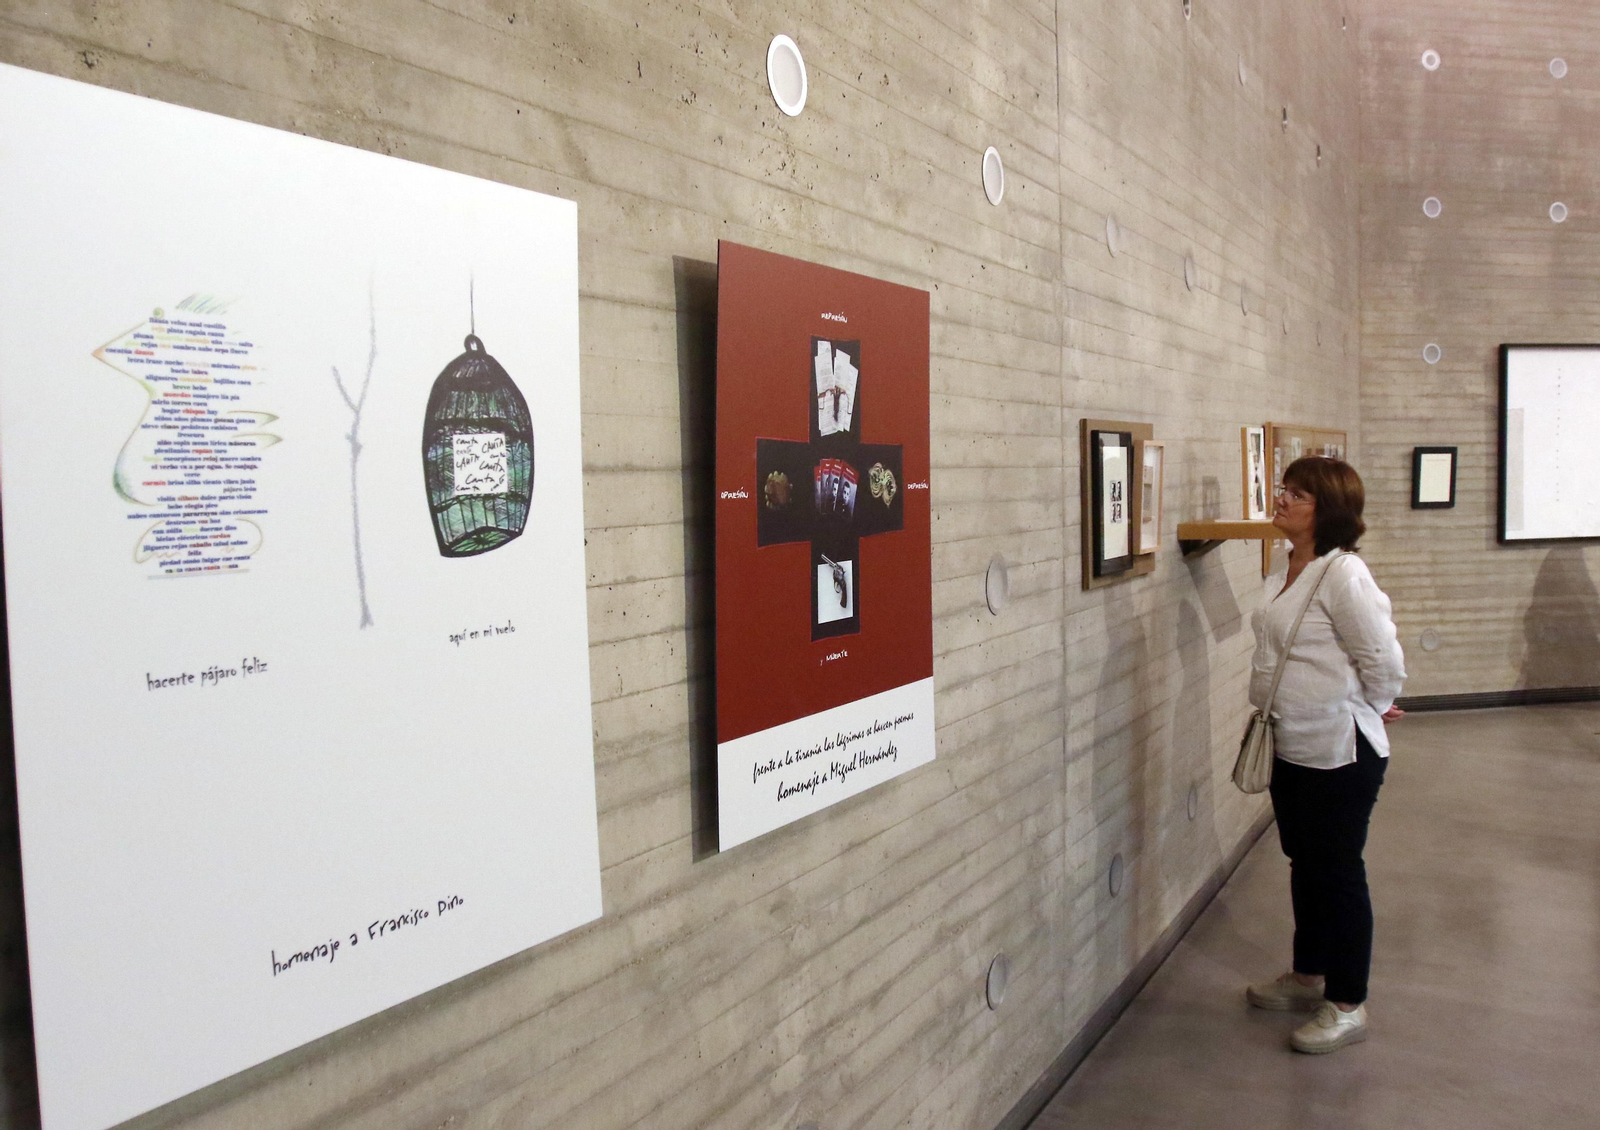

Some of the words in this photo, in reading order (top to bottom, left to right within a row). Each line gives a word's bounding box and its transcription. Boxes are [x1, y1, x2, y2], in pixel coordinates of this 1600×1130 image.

[449, 629, 467, 648] aquí
[470, 629, 480, 640] en
[483, 624, 493, 638] mi
[496, 620, 516, 636] vuelo
[146, 672, 195, 691] hacerte
[201, 666, 237, 687] pájaro
[242, 657, 268, 678] feliz
[753, 758, 776, 784] frente
[778, 760, 783, 769] a
[785, 750, 794, 766] la
[795, 744, 822, 763] tiranía
[823, 737, 835, 752] las
[836, 731, 865, 751] lágrimas
[866, 726, 872, 736] se
[894, 712, 914, 731] poemas
[777, 771, 819, 802] homenaje
[822, 773, 828, 783] a
[830, 753, 857, 783] Miguel
[858, 740, 898, 769] Hernández
[271, 938, 340, 977] homenaje
[349, 933, 358, 946] a
[367, 908, 429, 940] Francisco
